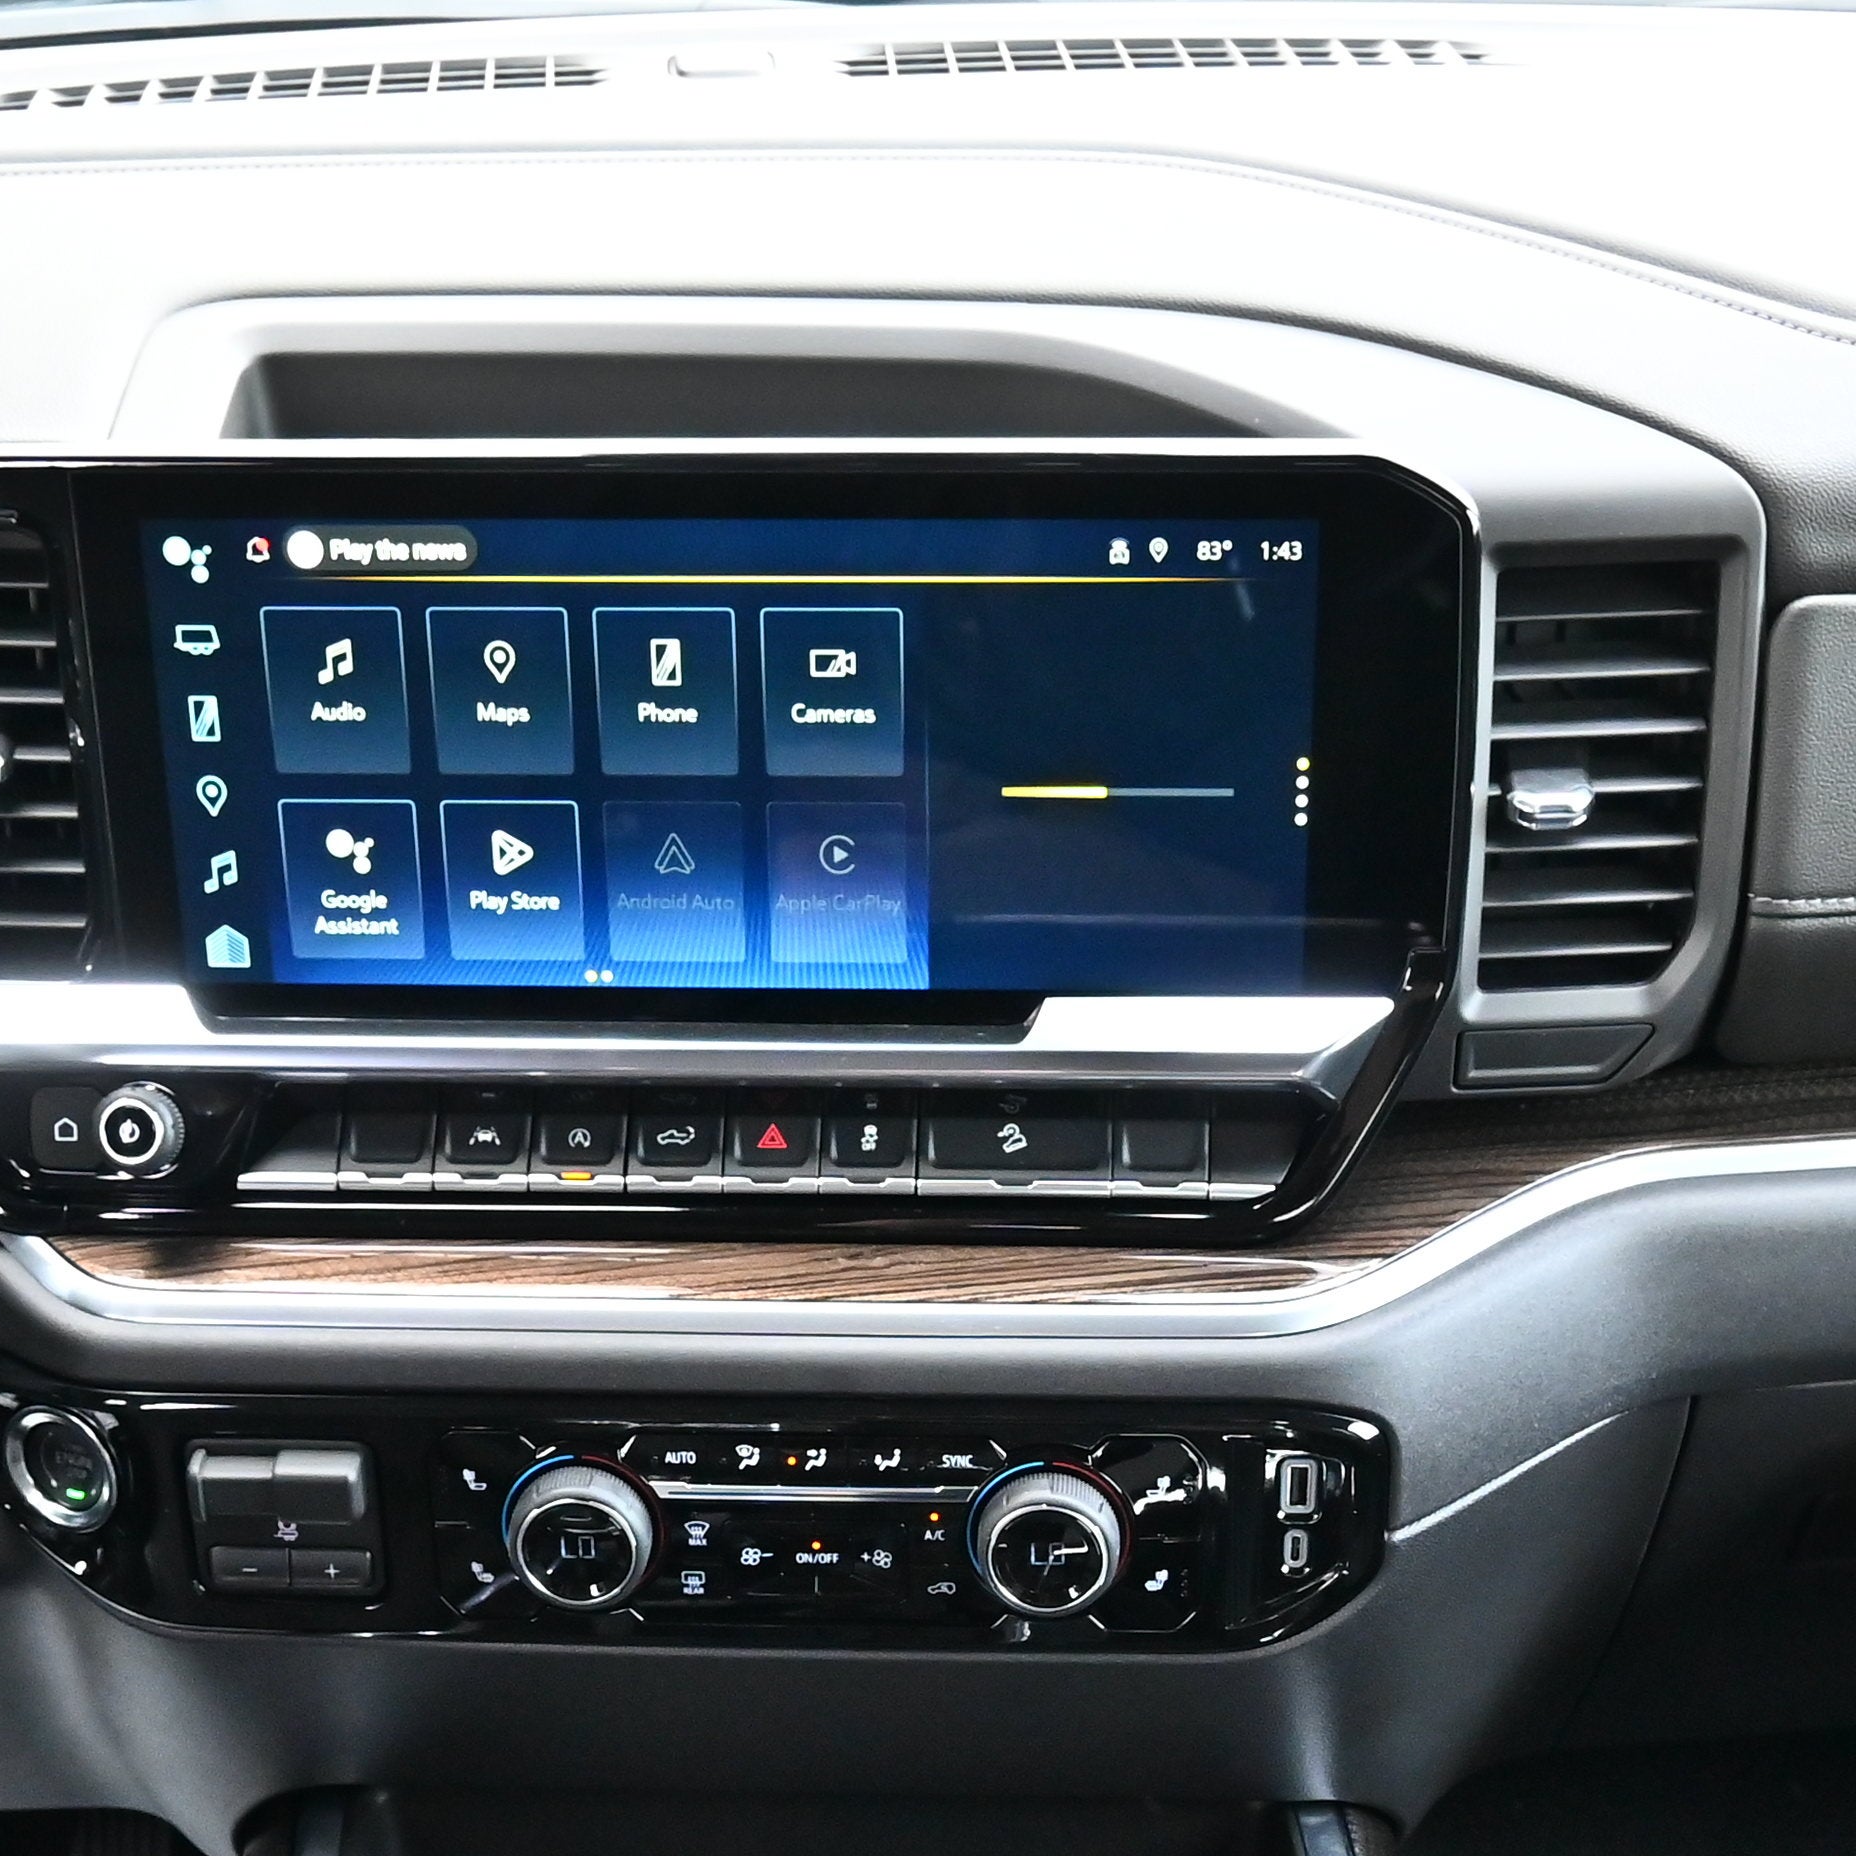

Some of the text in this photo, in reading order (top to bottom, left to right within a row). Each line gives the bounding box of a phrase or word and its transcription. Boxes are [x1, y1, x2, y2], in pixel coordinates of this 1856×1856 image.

[329, 538, 467, 565] Play the news
[1260, 540, 1303, 562] 1:43
[310, 701, 367, 722] Audio
[476, 701, 531, 726] Maps
[637, 701, 699, 724] Phone
[790, 702, 877, 724] Cameras
[320, 888, 388, 915] Google
[470, 890, 561, 915] Play Store
[616, 892, 735, 911] Android Auto
[776, 893, 902, 916] Apple CarPlay
[314, 916, 400, 936] Assistant
[664, 1451, 697, 1465] AUTO
[942, 1454, 974, 1469] SYNC
[924, 1529, 946, 1542] A/C
[560, 1535, 596, 1560] LO
[795, 1553, 839, 1564] ON/OFF
